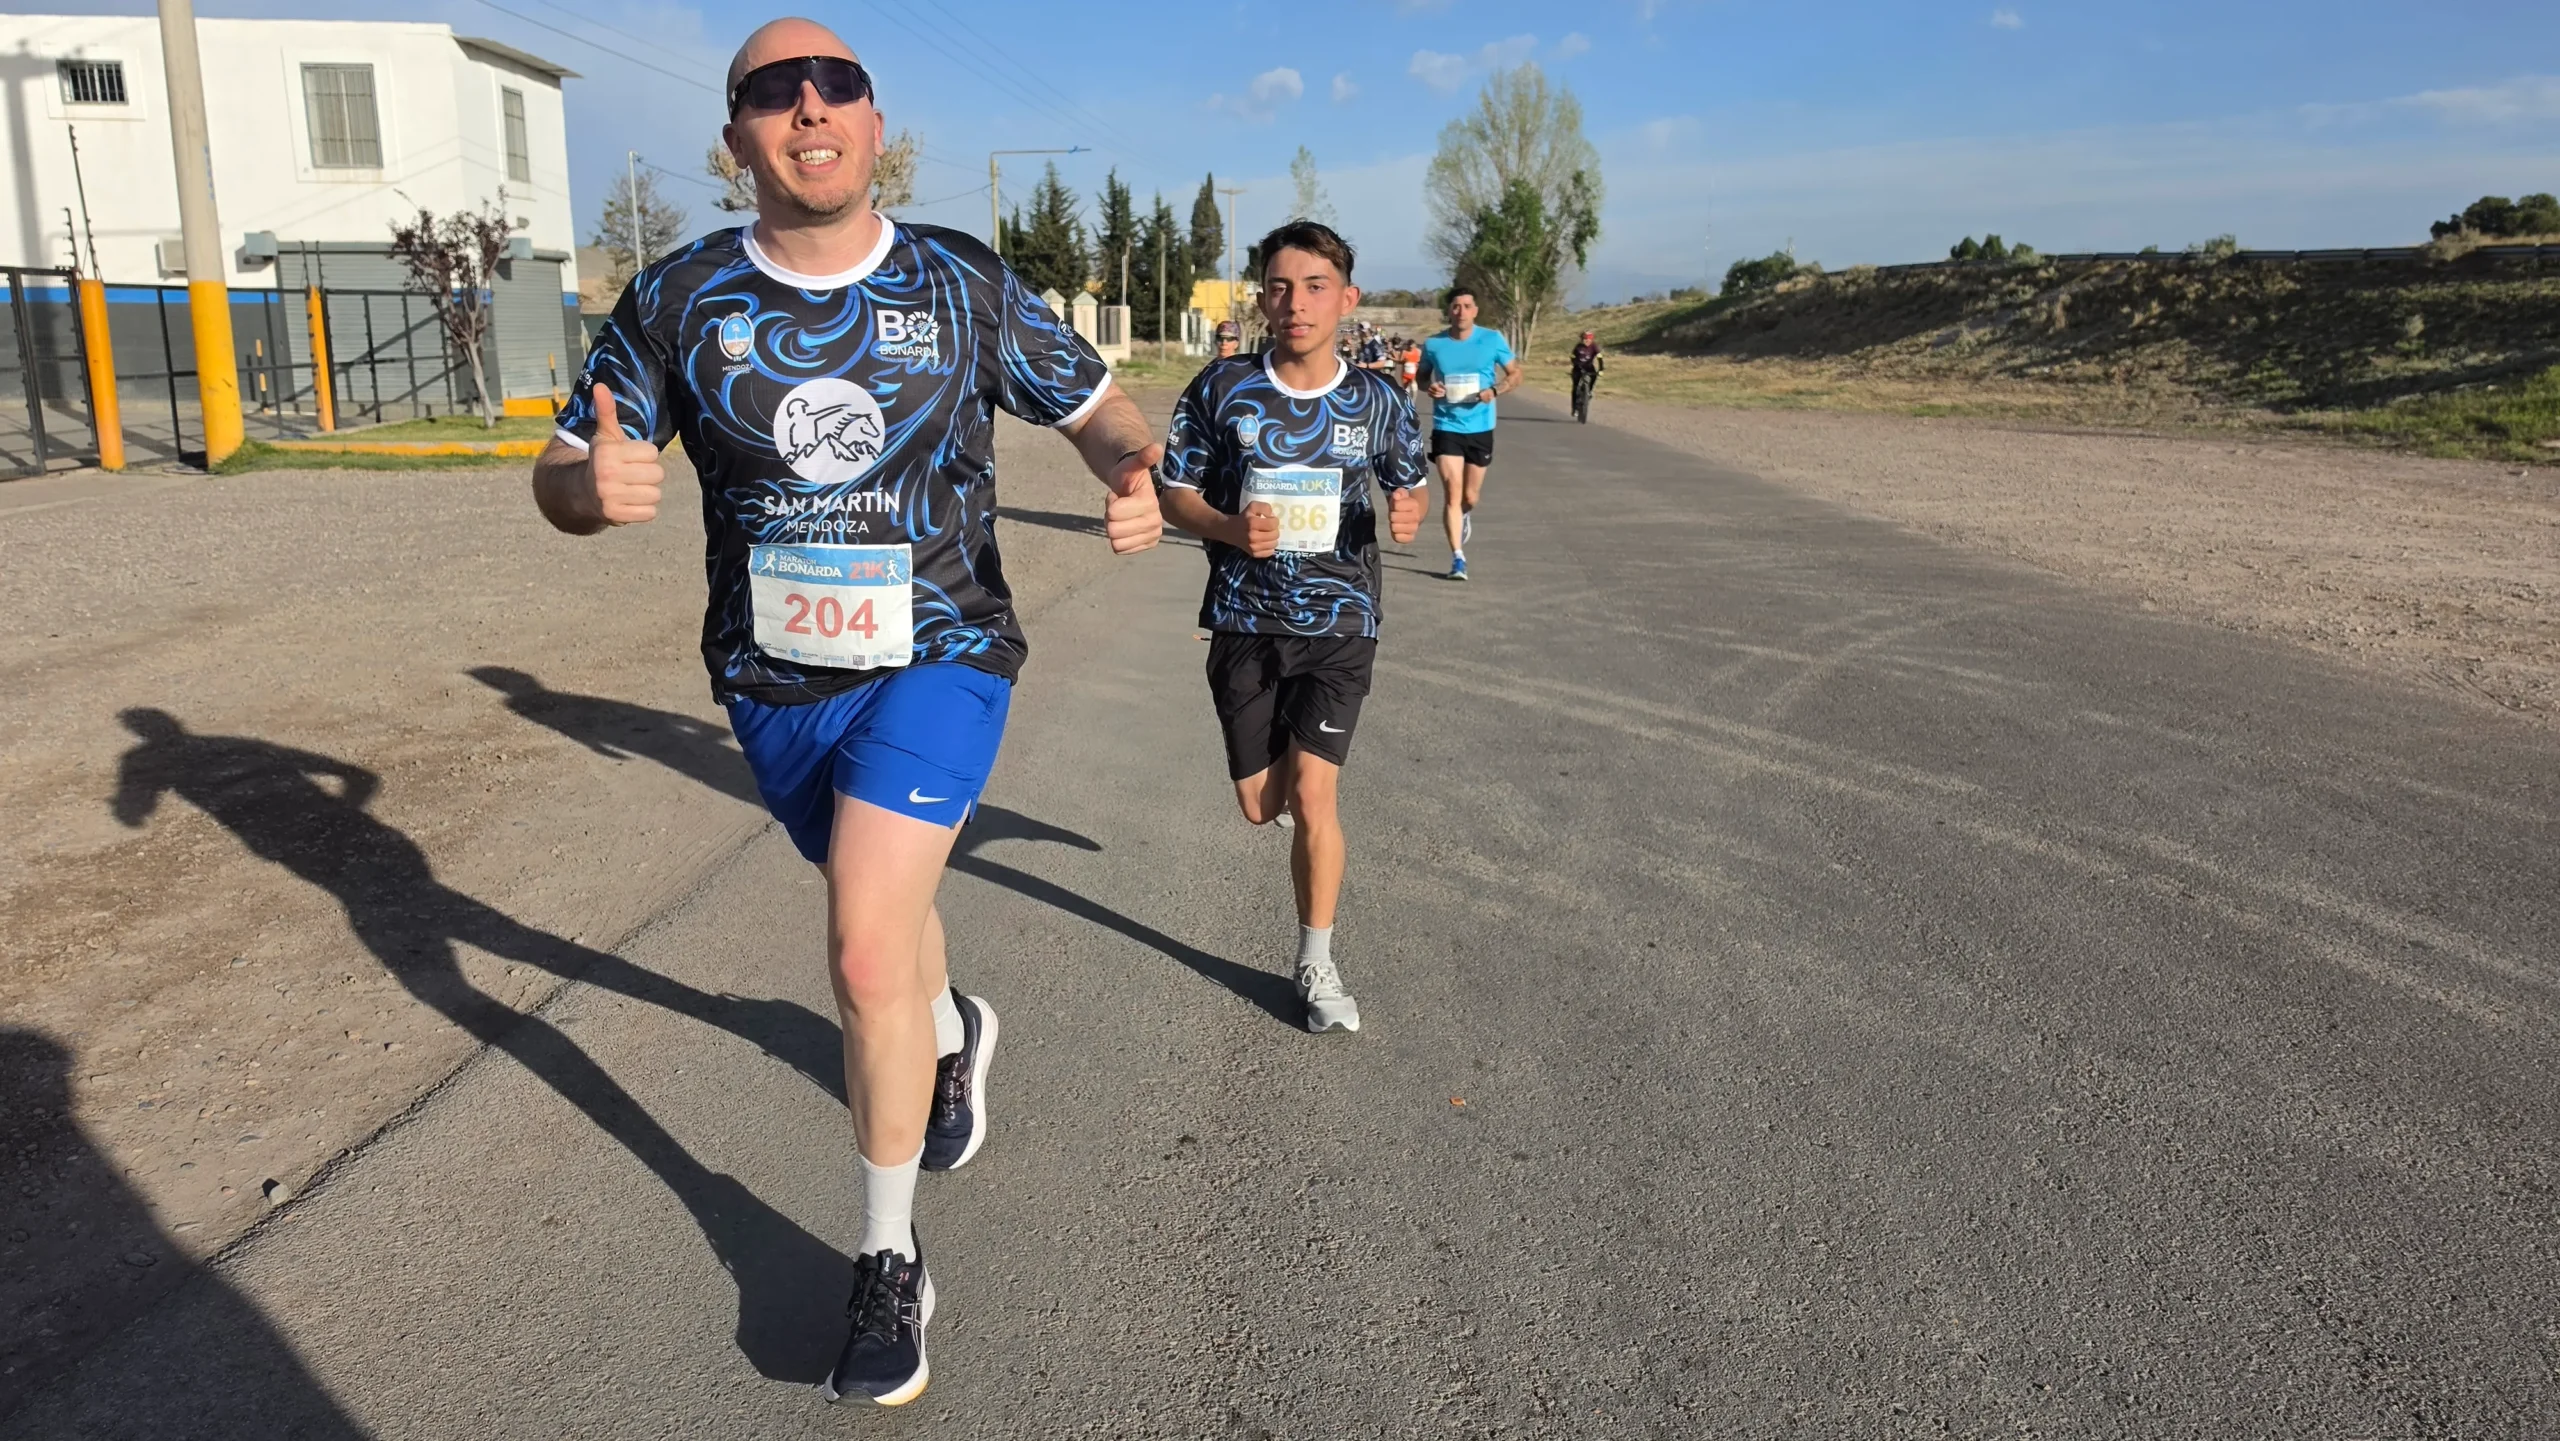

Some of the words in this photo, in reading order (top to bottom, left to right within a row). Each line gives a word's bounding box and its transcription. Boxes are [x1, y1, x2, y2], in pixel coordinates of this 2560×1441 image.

[880, 345, 940, 358] BONARDA
[722, 364, 754, 372] MENDOZA
[1256, 483, 1298, 491] BONARDA
[1302, 480, 1325, 492] 10K
[764, 495, 807, 516] SAN
[812, 487, 900, 514] MARTÍN
[786, 520, 870, 534] MENDOZA
[778, 562, 843, 578] BONARDA
[849, 562, 886, 580] 21K
[784, 593, 879, 640] 204
